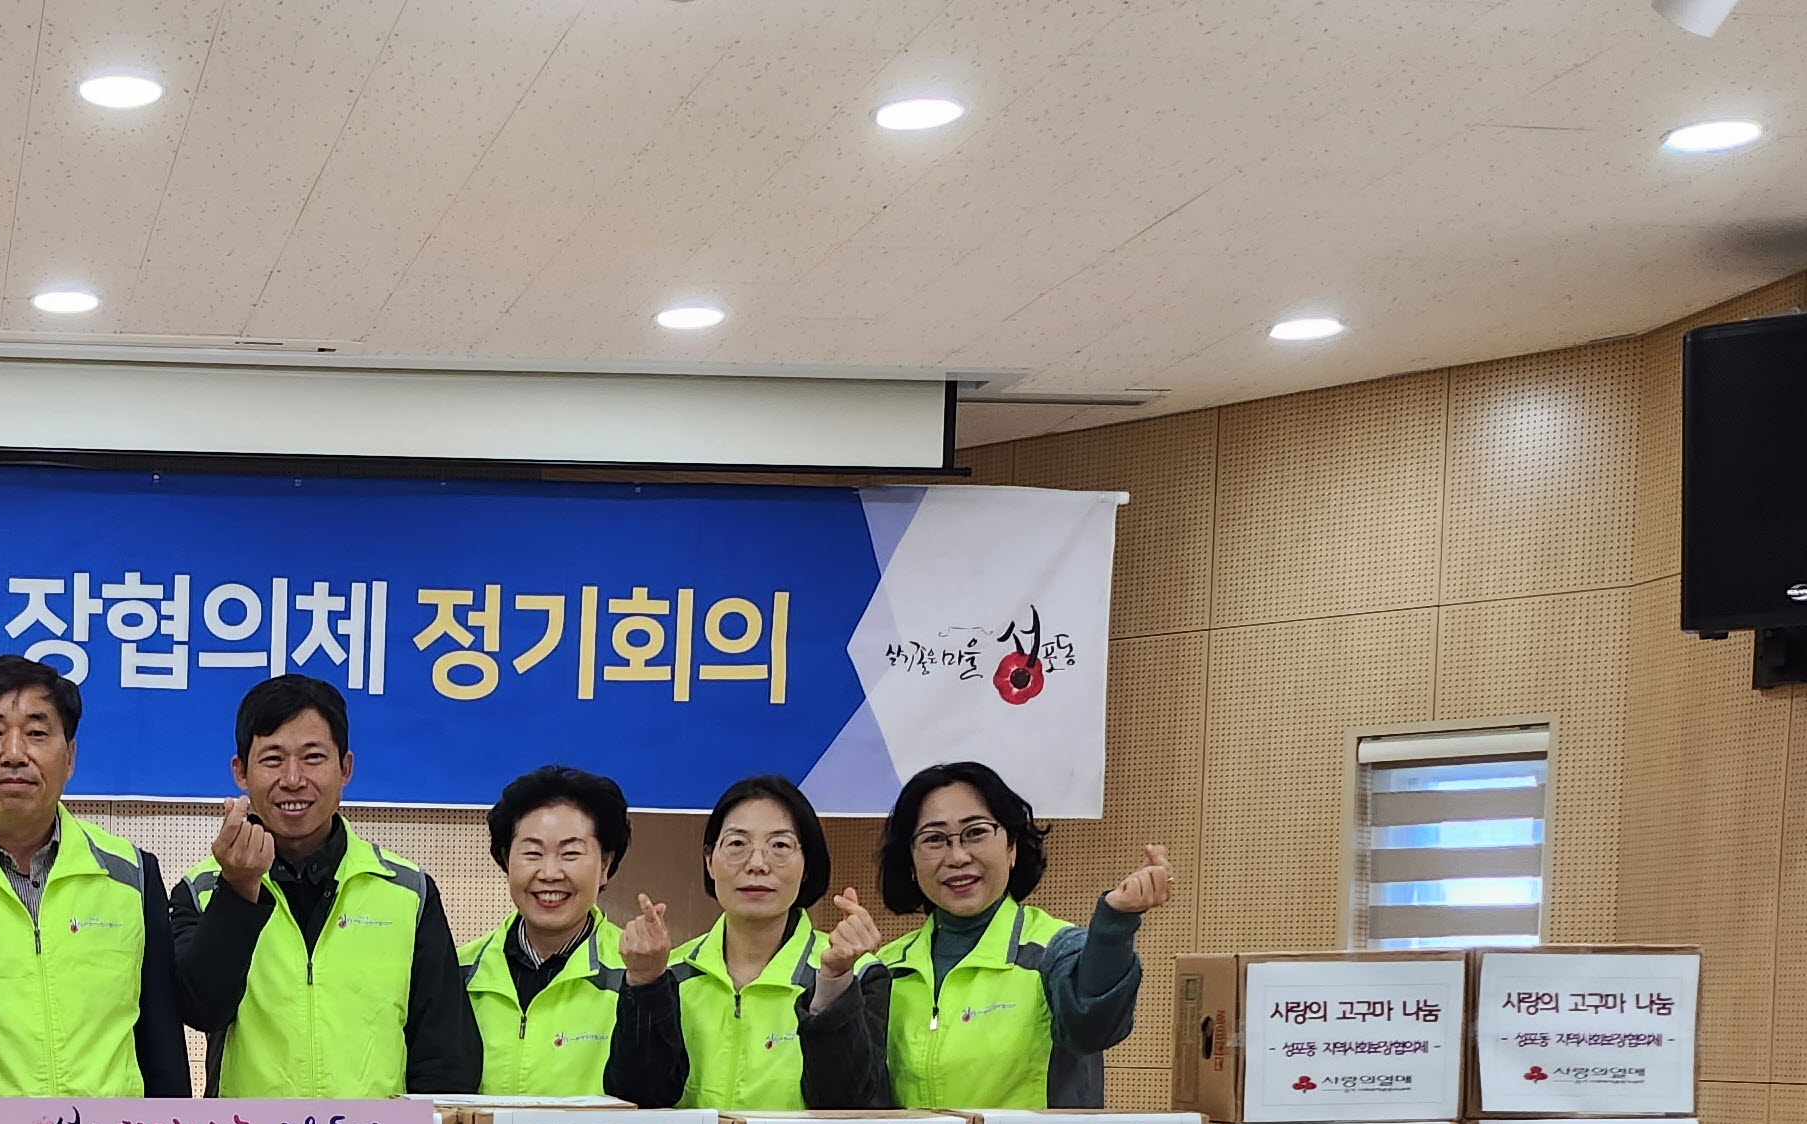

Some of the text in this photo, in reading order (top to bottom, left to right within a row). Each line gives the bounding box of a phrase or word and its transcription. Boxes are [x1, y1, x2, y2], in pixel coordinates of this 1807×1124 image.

[411, 583, 792, 706] 정기회의
[1269, 998, 1443, 1026] 사랑의 고구마 나눔
[1501, 991, 1676, 1017] 사랑의 고구마 나눔
[1281, 1039, 1429, 1058] 성포동 지역사회보장협의체
